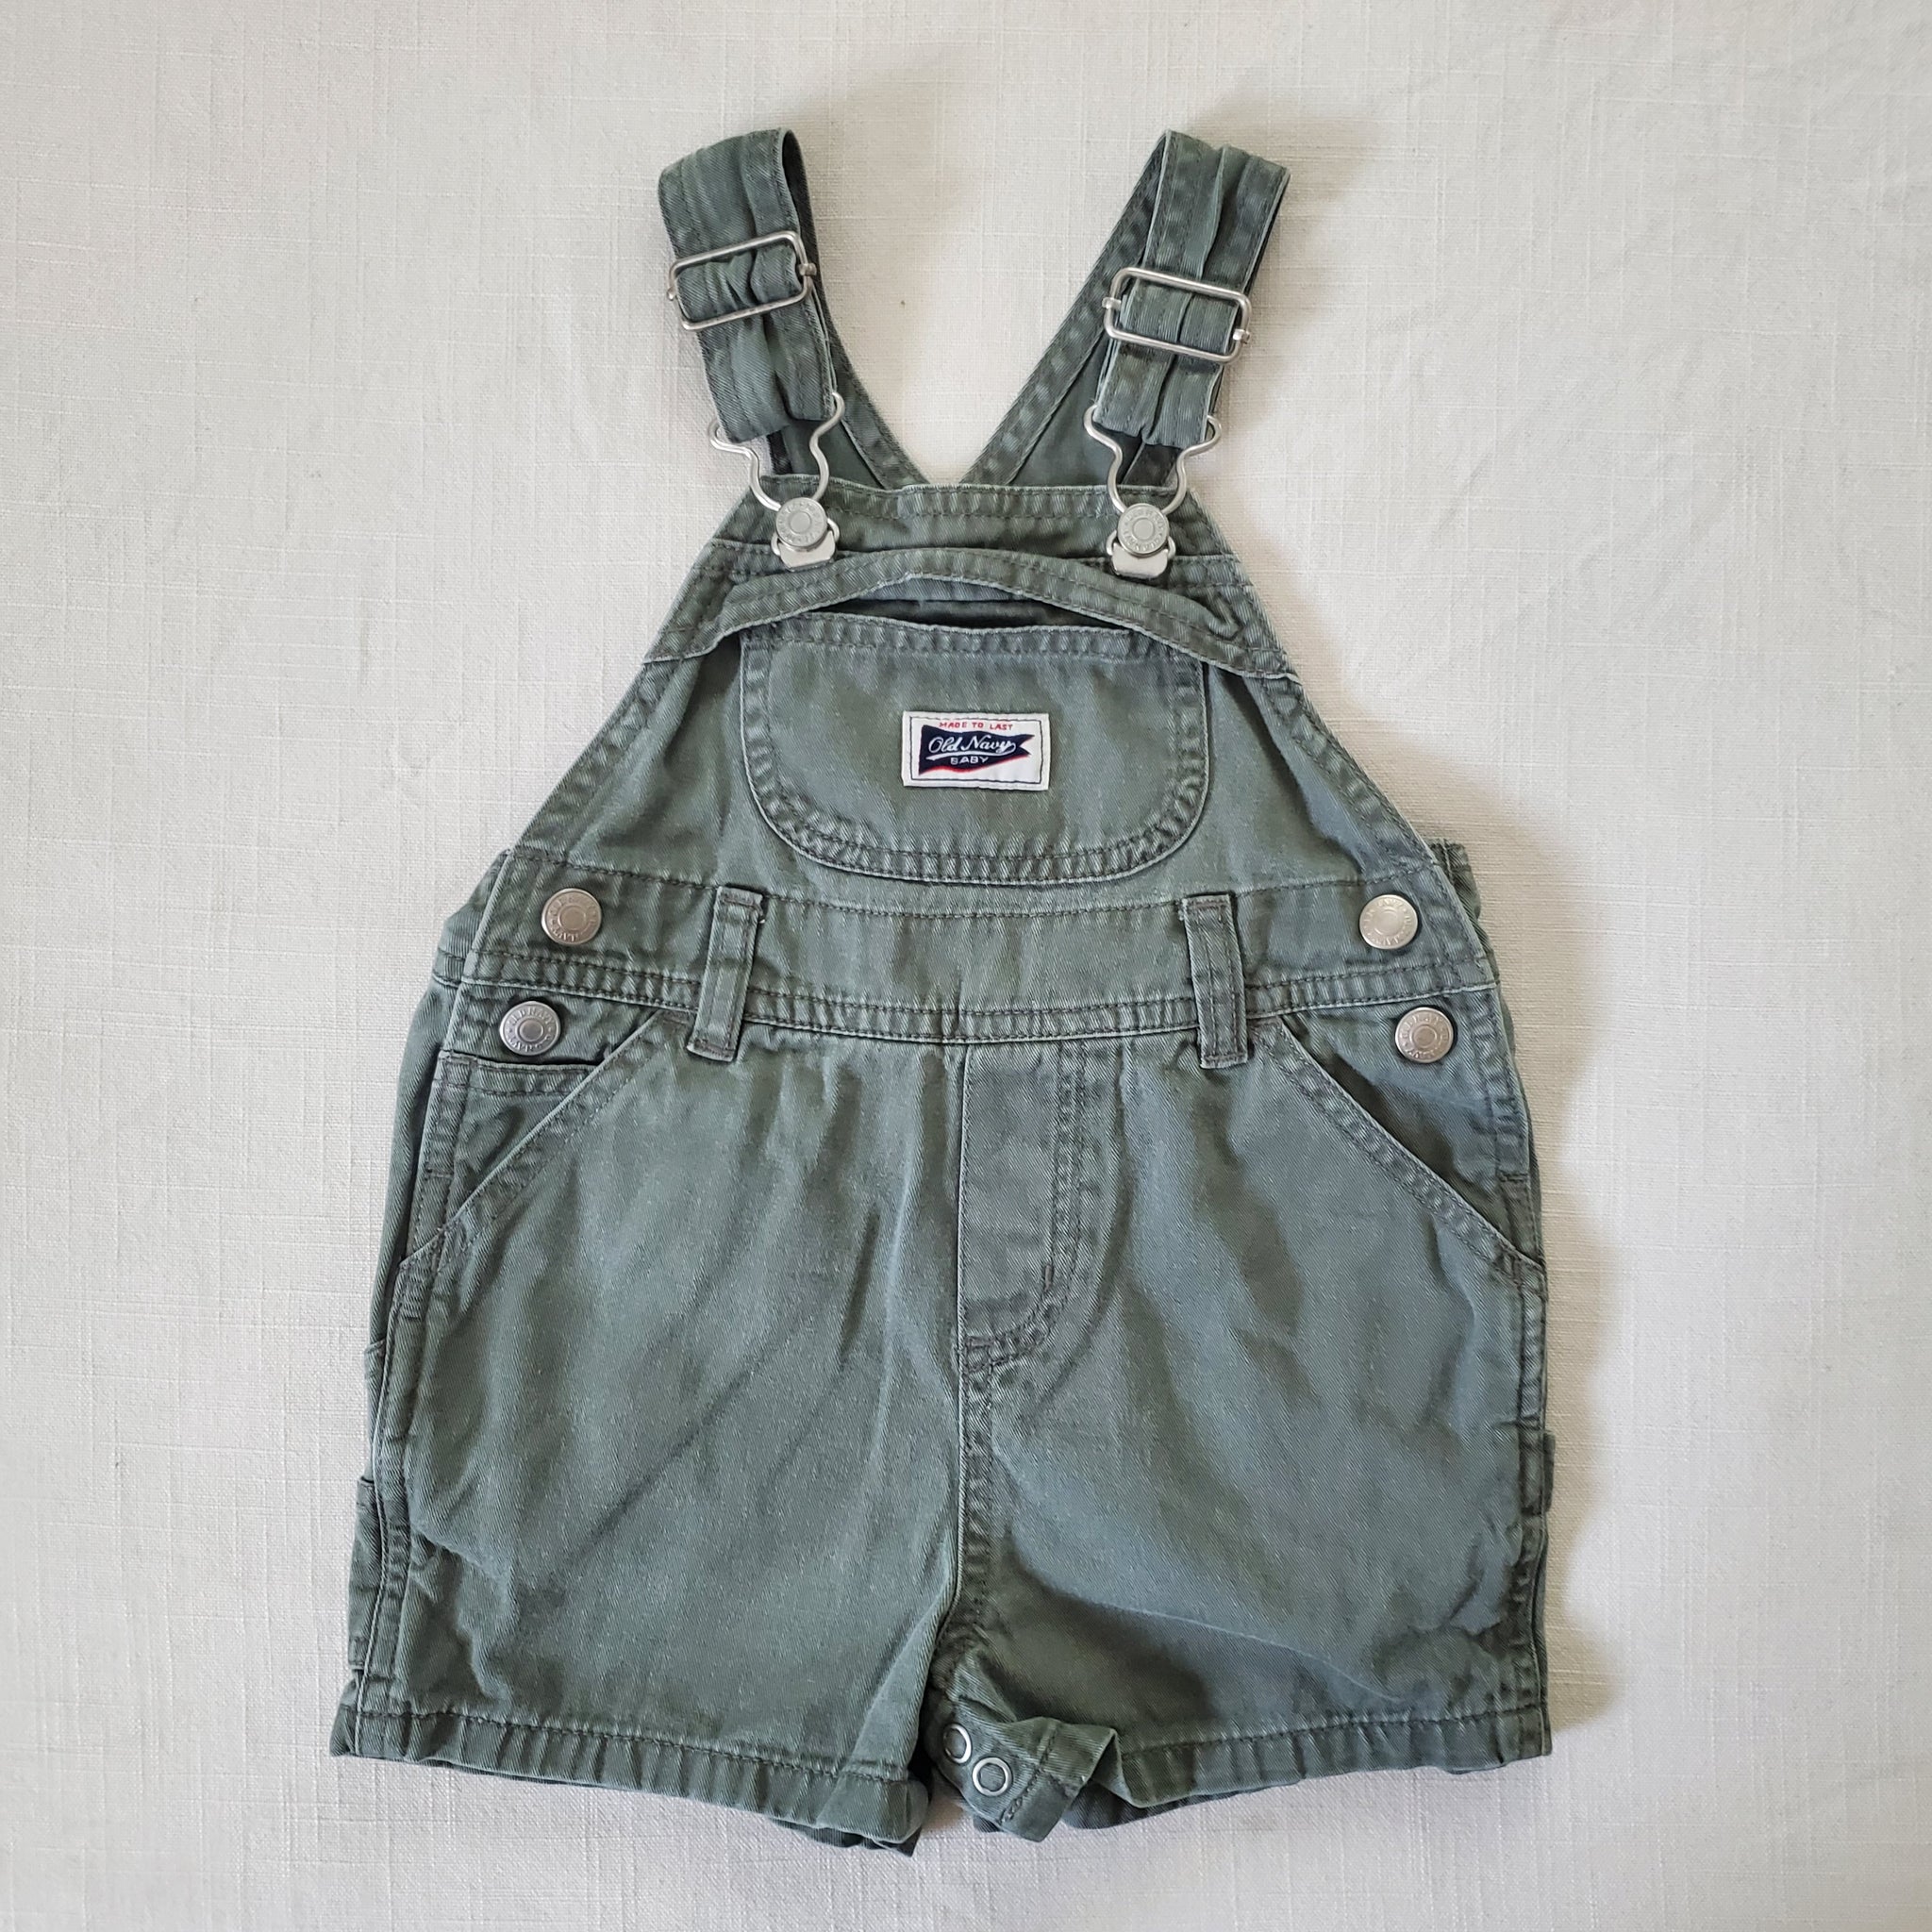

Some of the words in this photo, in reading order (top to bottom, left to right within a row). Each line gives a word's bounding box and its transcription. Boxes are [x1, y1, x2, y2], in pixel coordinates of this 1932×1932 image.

[928, 736, 962, 754] Old
[960, 735, 1017, 755] Navy
[950, 756, 990, 765] BABY
